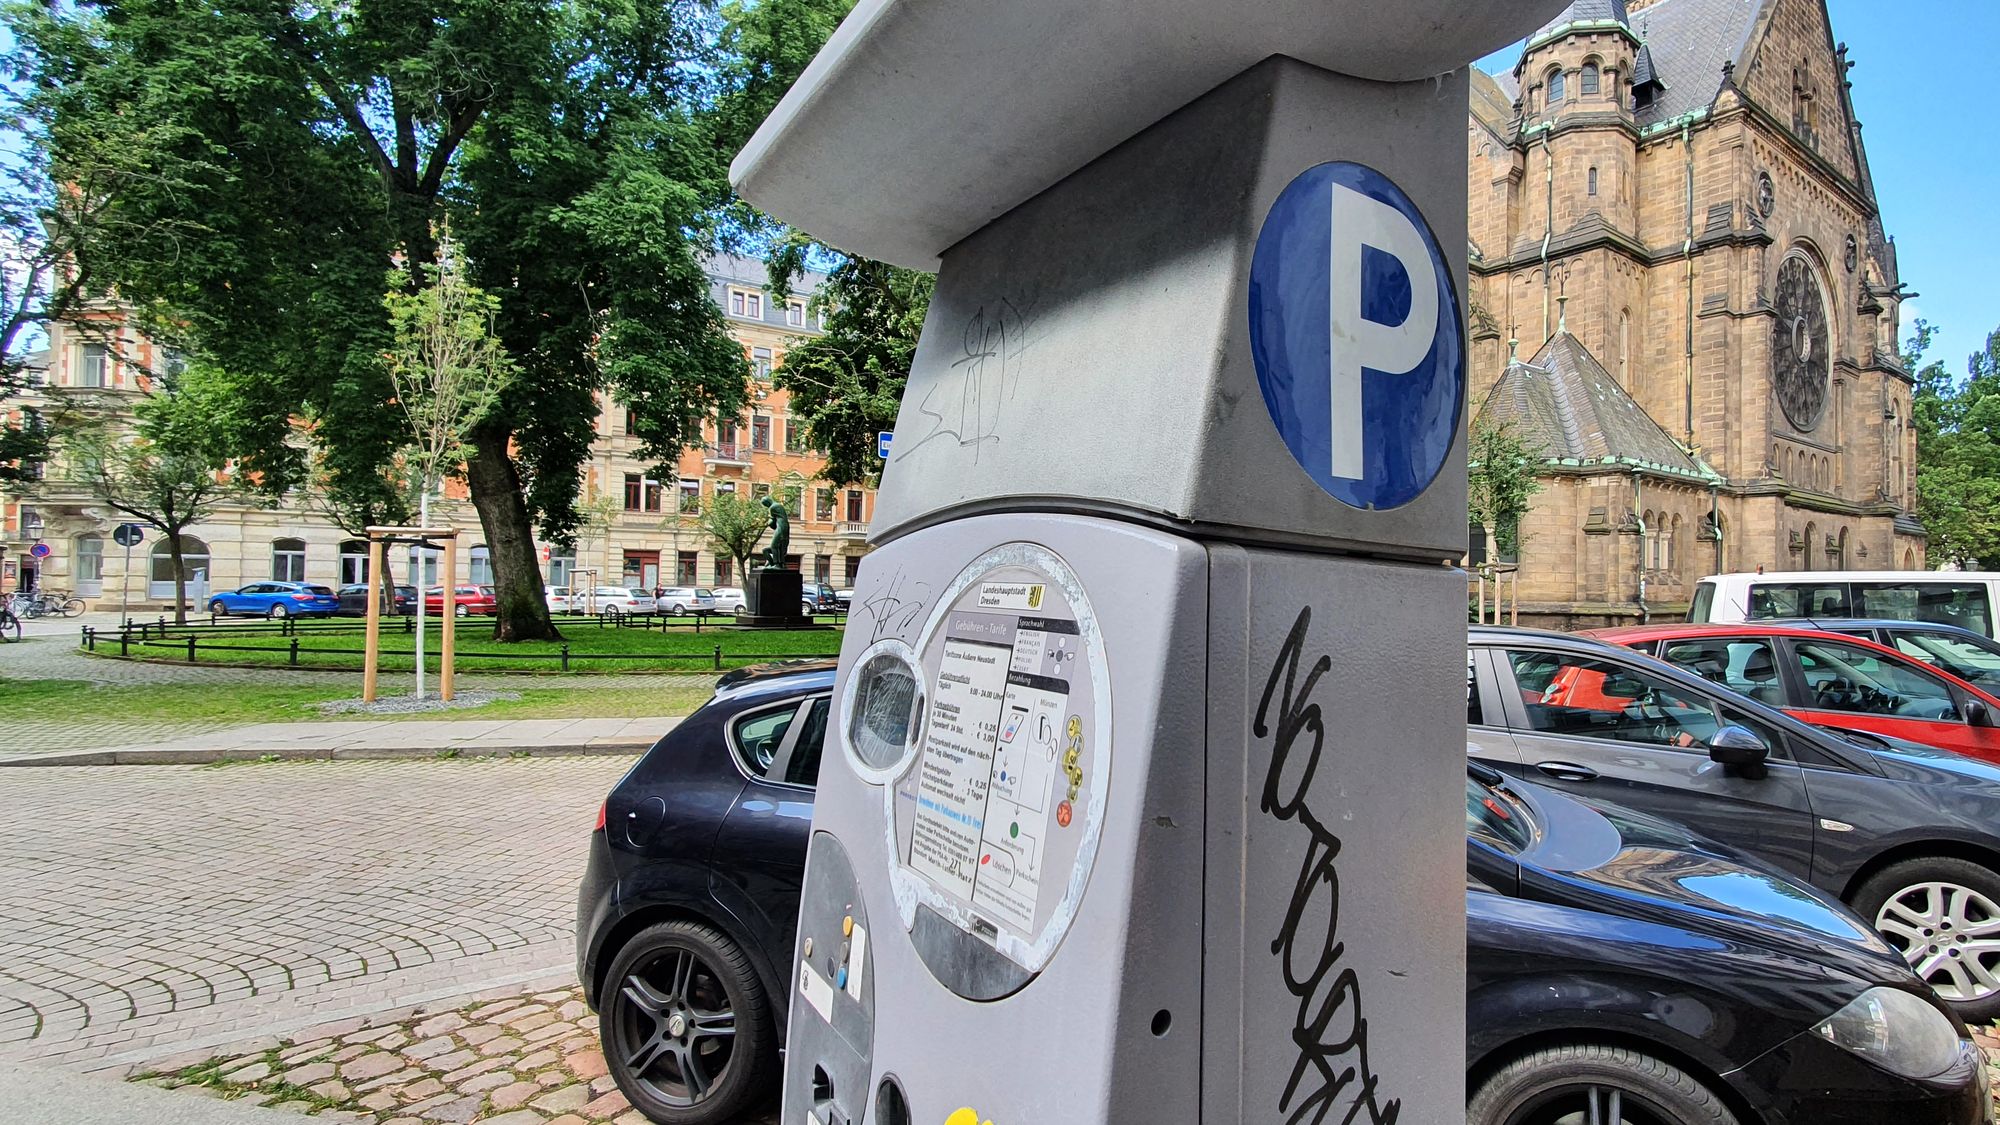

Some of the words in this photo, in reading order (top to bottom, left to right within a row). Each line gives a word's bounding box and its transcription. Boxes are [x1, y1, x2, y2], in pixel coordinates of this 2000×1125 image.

[1329, 181, 1439, 481] P
[982, 586, 1027, 597] Landeshauptstadt
[980, 596, 1000, 606] Dresden
[955, 620, 984, 633] Gebühren
[989, 623, 1007, 636] Tarife
[1019, 619, 1045, 629] Sprachwahl
[1008, 673, 1032, 686] Bezahlung
[971, 789, 983, 800] Tage
[993, 859, 1012, 875] Löschen
